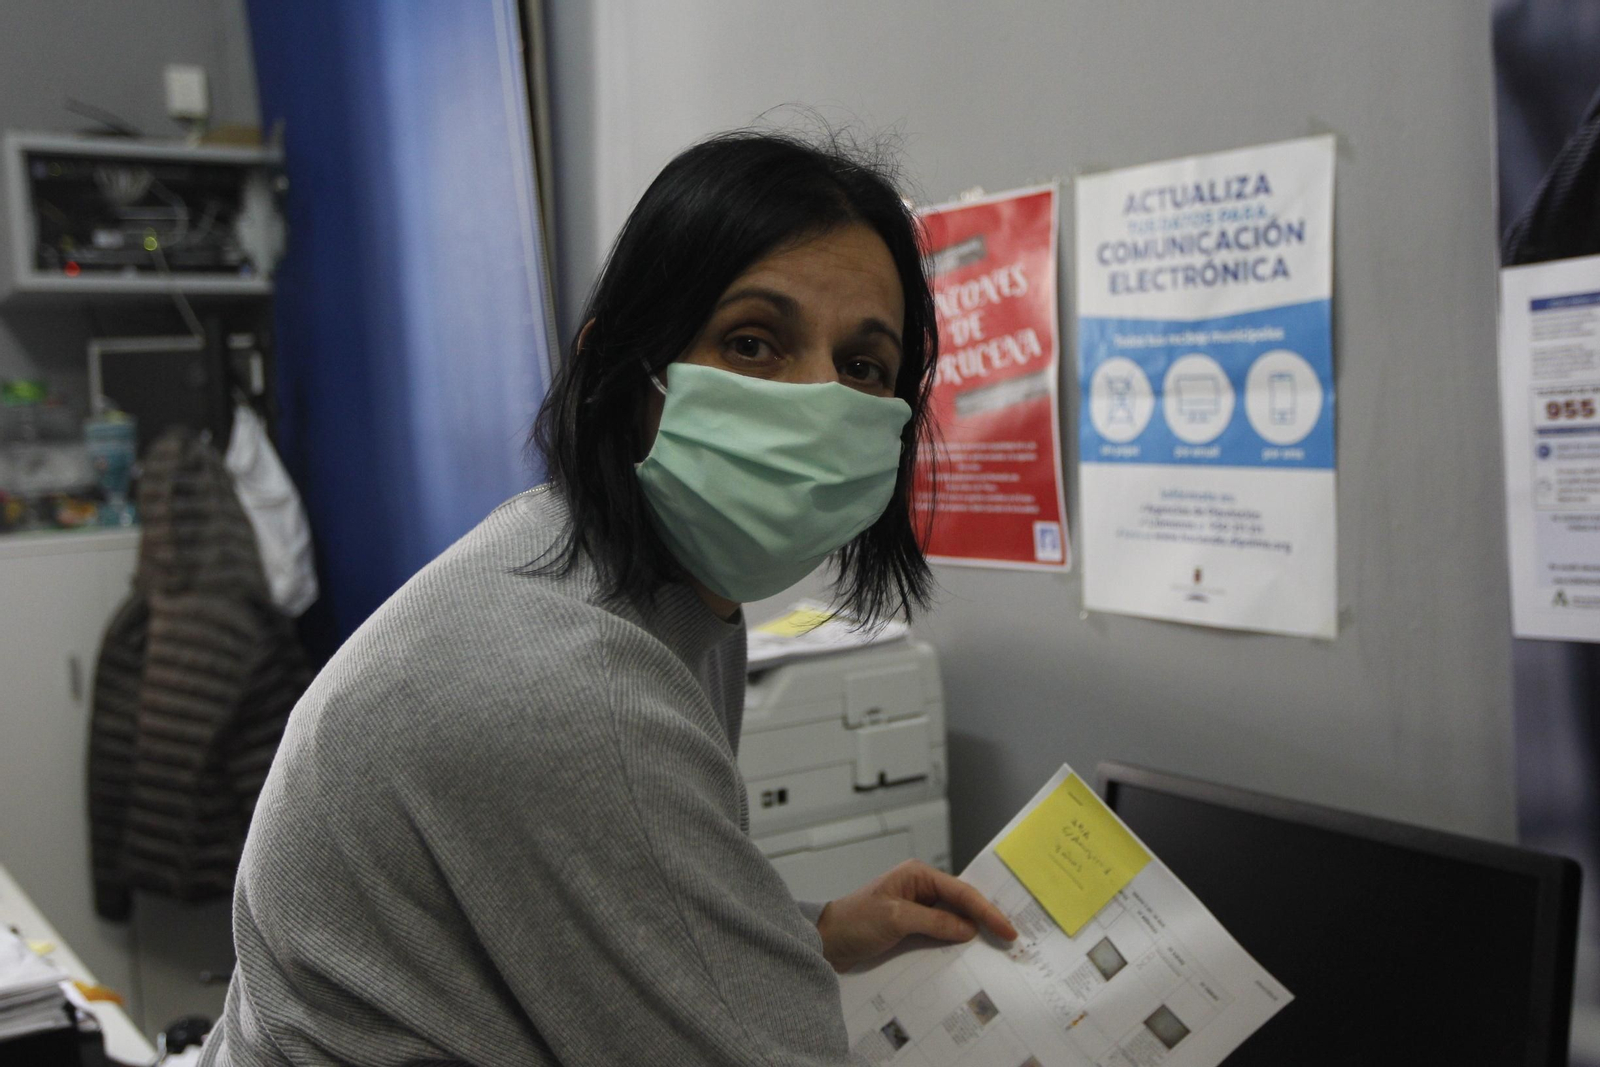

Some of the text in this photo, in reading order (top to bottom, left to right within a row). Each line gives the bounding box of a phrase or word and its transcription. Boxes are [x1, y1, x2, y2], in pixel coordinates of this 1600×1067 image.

[1123, 171, 1272, 216] ACTUALIZA
[1159, 210, 1212, 232] DATOS
[1218, 204, 1267, 223] PARA
[1096, 217, 1307, 267] COMUNICACIÓN
[1109, 257, 1291, 295] ELECTRÓNICA
[948, 309, 986, 348] DE
[1545, 398, 1597, 421] 955
